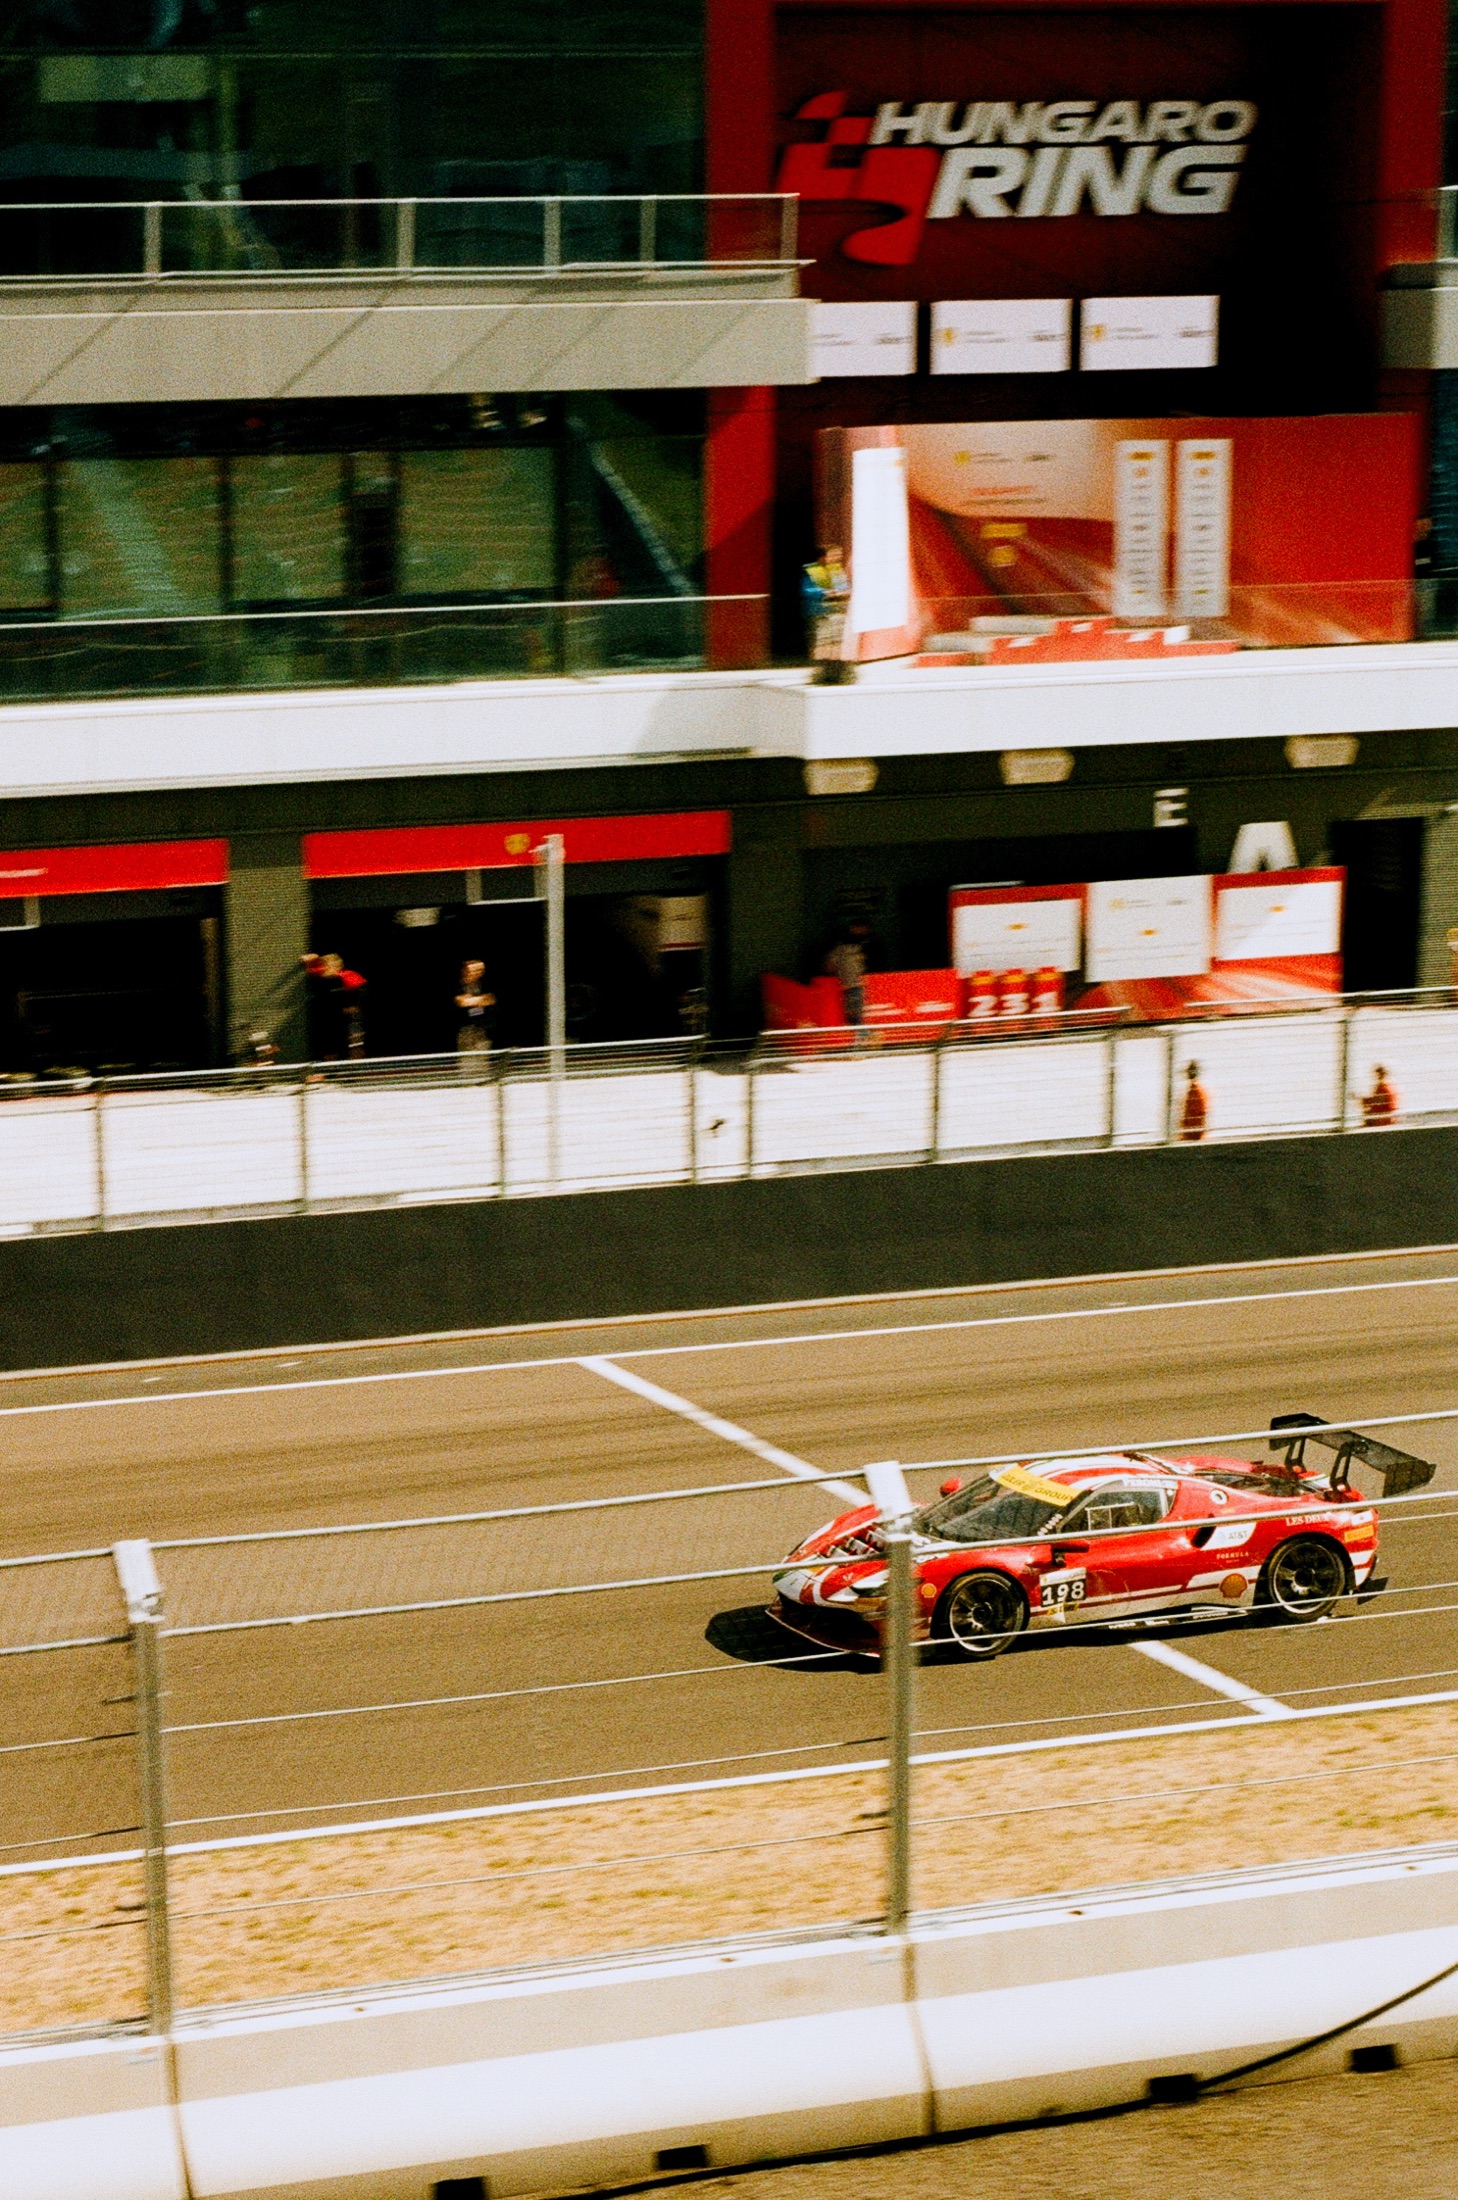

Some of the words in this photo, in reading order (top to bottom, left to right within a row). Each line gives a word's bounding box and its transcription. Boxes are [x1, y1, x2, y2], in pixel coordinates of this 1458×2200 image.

[868, 100, 1259, 145] HUNGARO
[926, 144, 1250, 219] RING
[1153, 788, 1190, 827] E
[967, 994, 998, 1018] 2
[999, 992, 1030, 1016] 3
[1031, 991, 1061, 1014] 1
[1285, 1515, 1304, 1527] LES
[1228, 1529, 1248, 1540] AT&T
[1216, 1551, 1250, 1560] FORMULA
[1041, 1581, 1085, 1606] 198
